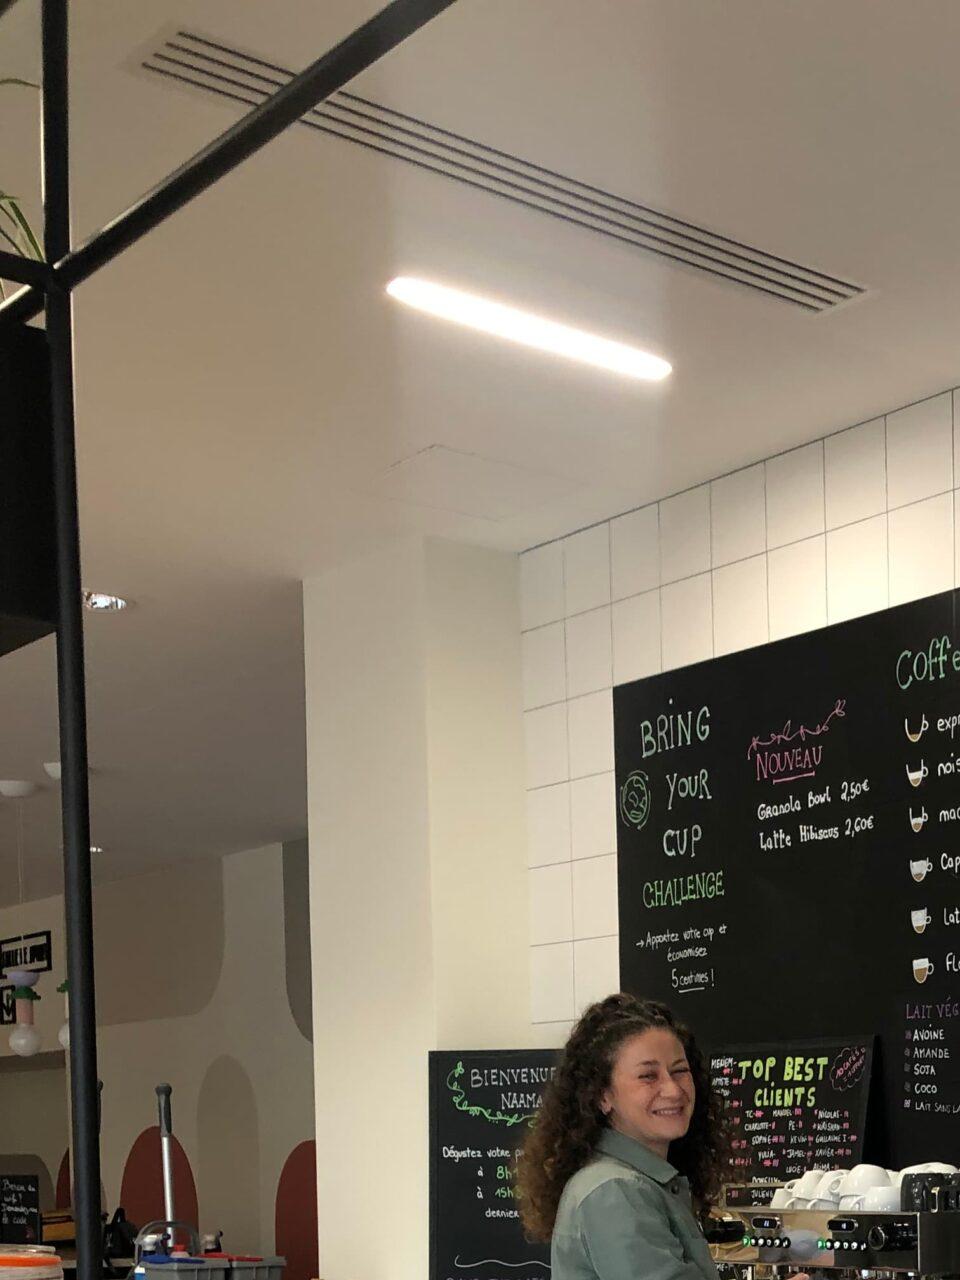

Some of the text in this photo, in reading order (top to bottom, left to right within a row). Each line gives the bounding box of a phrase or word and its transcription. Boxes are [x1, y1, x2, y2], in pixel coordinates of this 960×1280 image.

[756, 746, 823, 781] NOUVEAU
[666, 769, 712, 810] YOUR
[808, 786, 831, 808] Bowl
[841, 779, 870, 802] 2,50€
[663, 825, 702, 857] CUP
[759, 815, 874, 851] Latte Hibiscus 2,60€
[643, 870, 725, 908] CHALLENGE
[672, 968, 679, 988] 5
[906, 1003, 932, 1019] LAIT
[913, 1047, 950, 1059] AMANDE
[738, 1056, 776, 1081] TOP
[783, 1056, 829, 1081] BEST
[914, 1083, 938, 1095] COCO
[442, 1146, 483, 1162] Dégustez
[487, 1147, 511, 1158] votre
[477, 1166, 484, 1177] à
[477, 1187, 484, 1199] à
